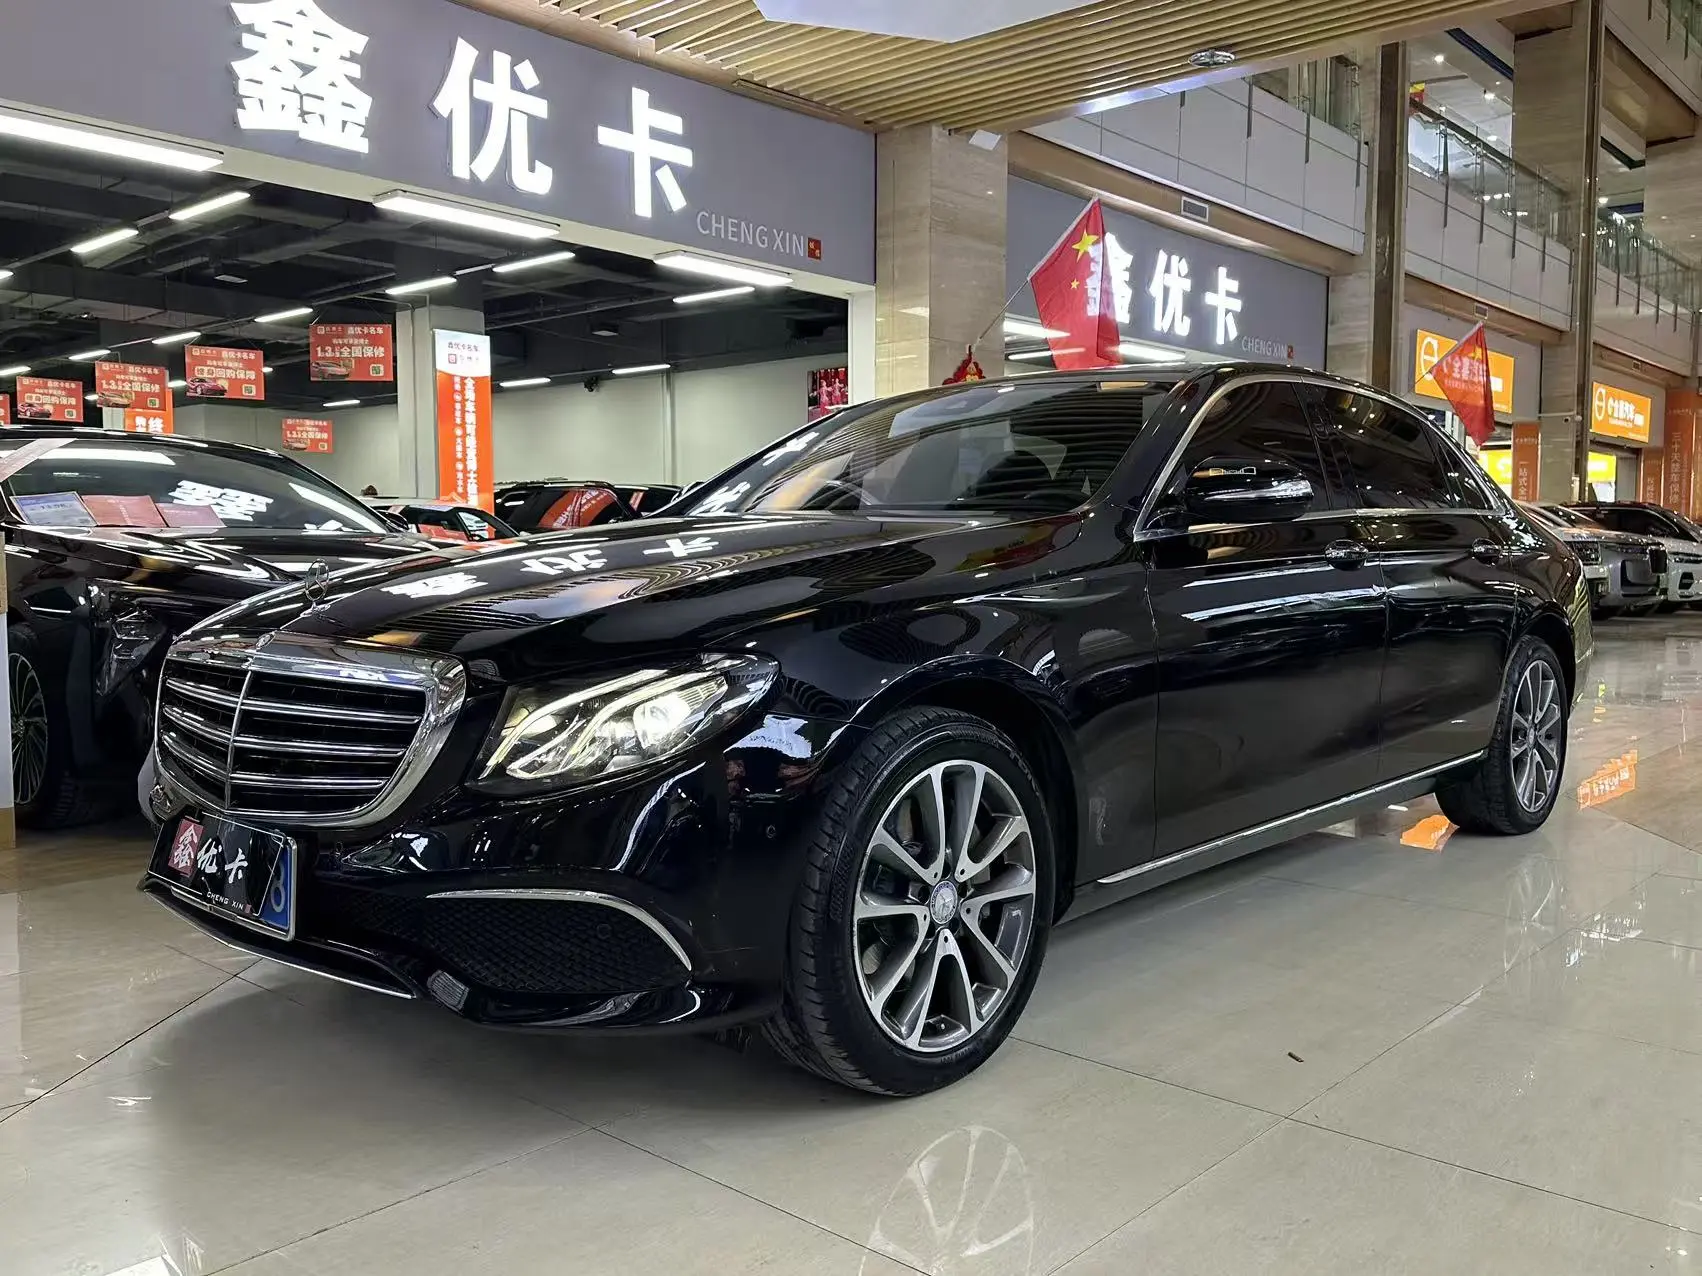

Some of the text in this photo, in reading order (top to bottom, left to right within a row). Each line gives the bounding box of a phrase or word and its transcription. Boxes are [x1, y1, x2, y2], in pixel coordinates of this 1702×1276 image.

[230, 0, 693, 218] 鑫优卡
[696, 211, 804, 257] CHENG XIN
[1242, 336, 1287, 359] CHENG XIN
[206, 891, 245, 911] CHENG XIN
